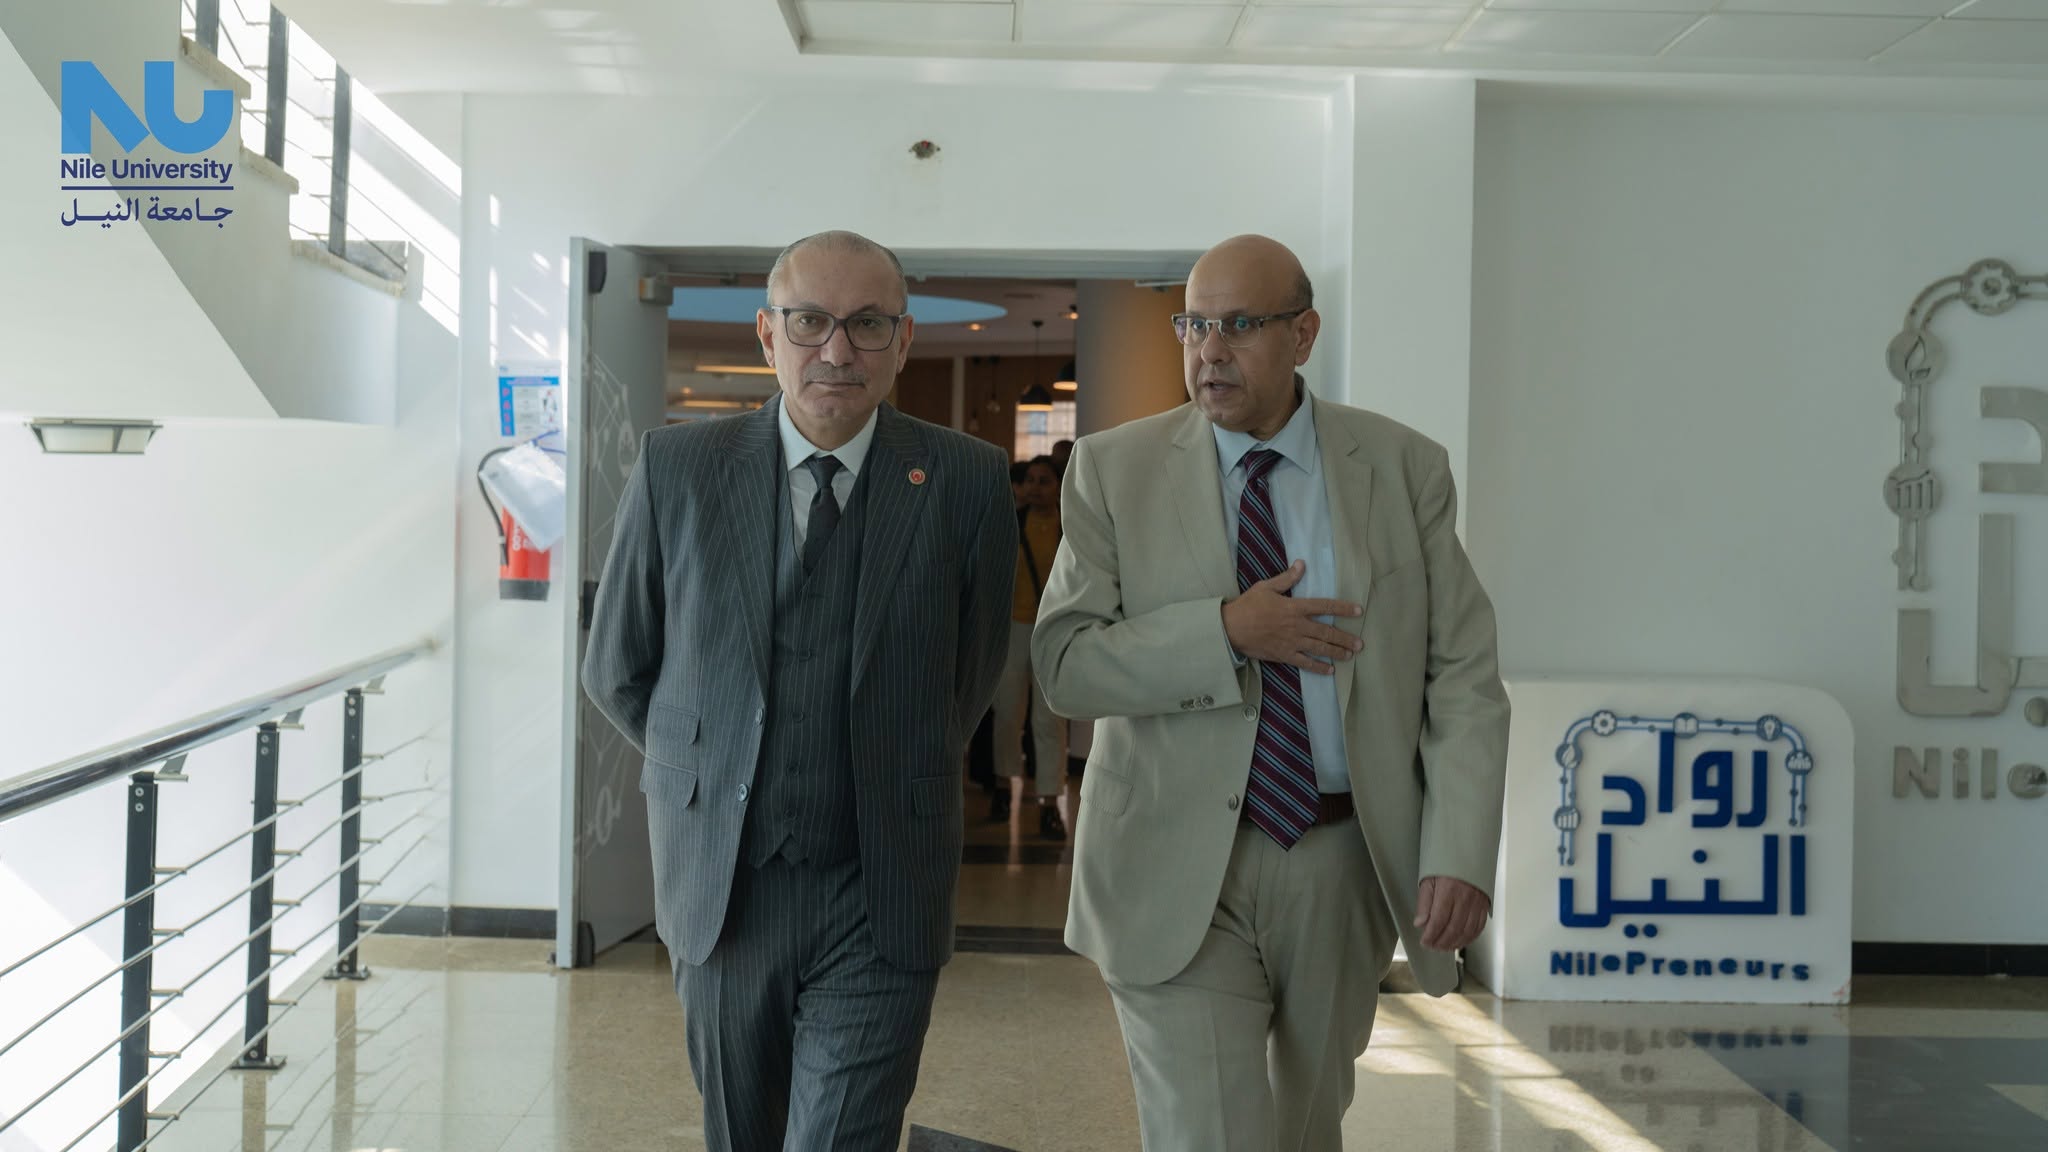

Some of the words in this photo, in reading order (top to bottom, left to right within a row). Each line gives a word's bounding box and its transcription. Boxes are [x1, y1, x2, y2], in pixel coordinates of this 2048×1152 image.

[1601, 730, 1768, 828] رواد
[1559, 832, 1806, 939] النيل
[1550, 951, 1810, 981] NilePreneurs
